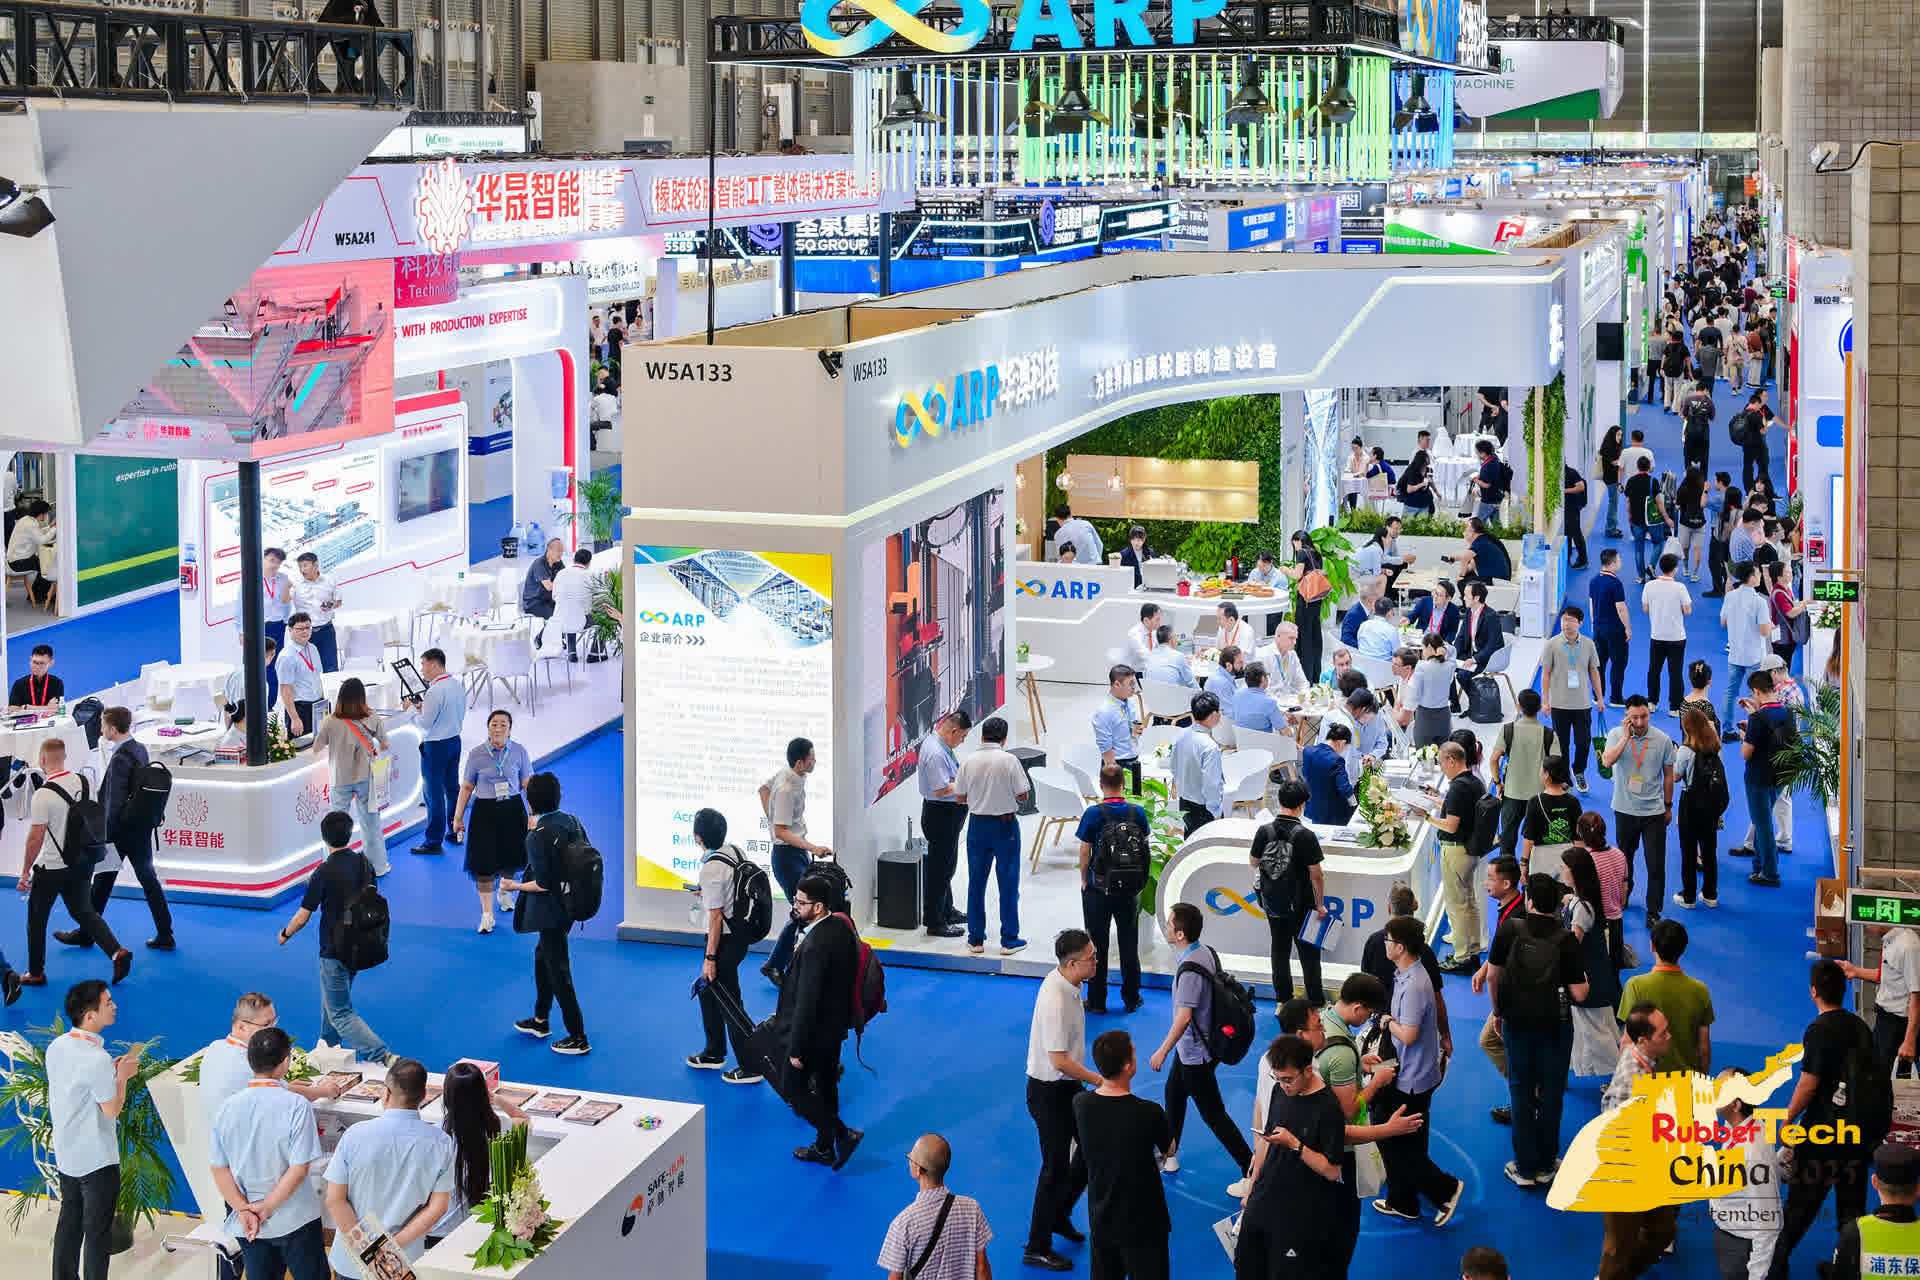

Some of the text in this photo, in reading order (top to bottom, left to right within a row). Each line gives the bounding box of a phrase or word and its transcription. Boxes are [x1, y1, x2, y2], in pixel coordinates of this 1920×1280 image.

[1009, 0, 1228, 50] ARP
[476, 171, 580, 222] 华晟智能
[335, 232, 376, 246] W5A241
[818, 238, 868, 251] GROUP
[402, 322, 426, 338] WITH
[430, 315, 485, 335] PRODUCTION
[489, 308, 528, 326] EXPERTISE
[646, 362, 733, 383] W5A133
[852, 357, 887, 382] W5A133
[950, 364, 1000, 432] ARP
[152, 465, 159, 474] in
[1051, 579, 1101, 600] ARP
[672, 612, 705, 628] ARP
[639, 631, 684, 646] 企业简介
[163, 829, 225, 849] 华晟智能
[1323, 895, 1375, 928] RP
[1870, 1256, 1920, 1275] 浦东保
